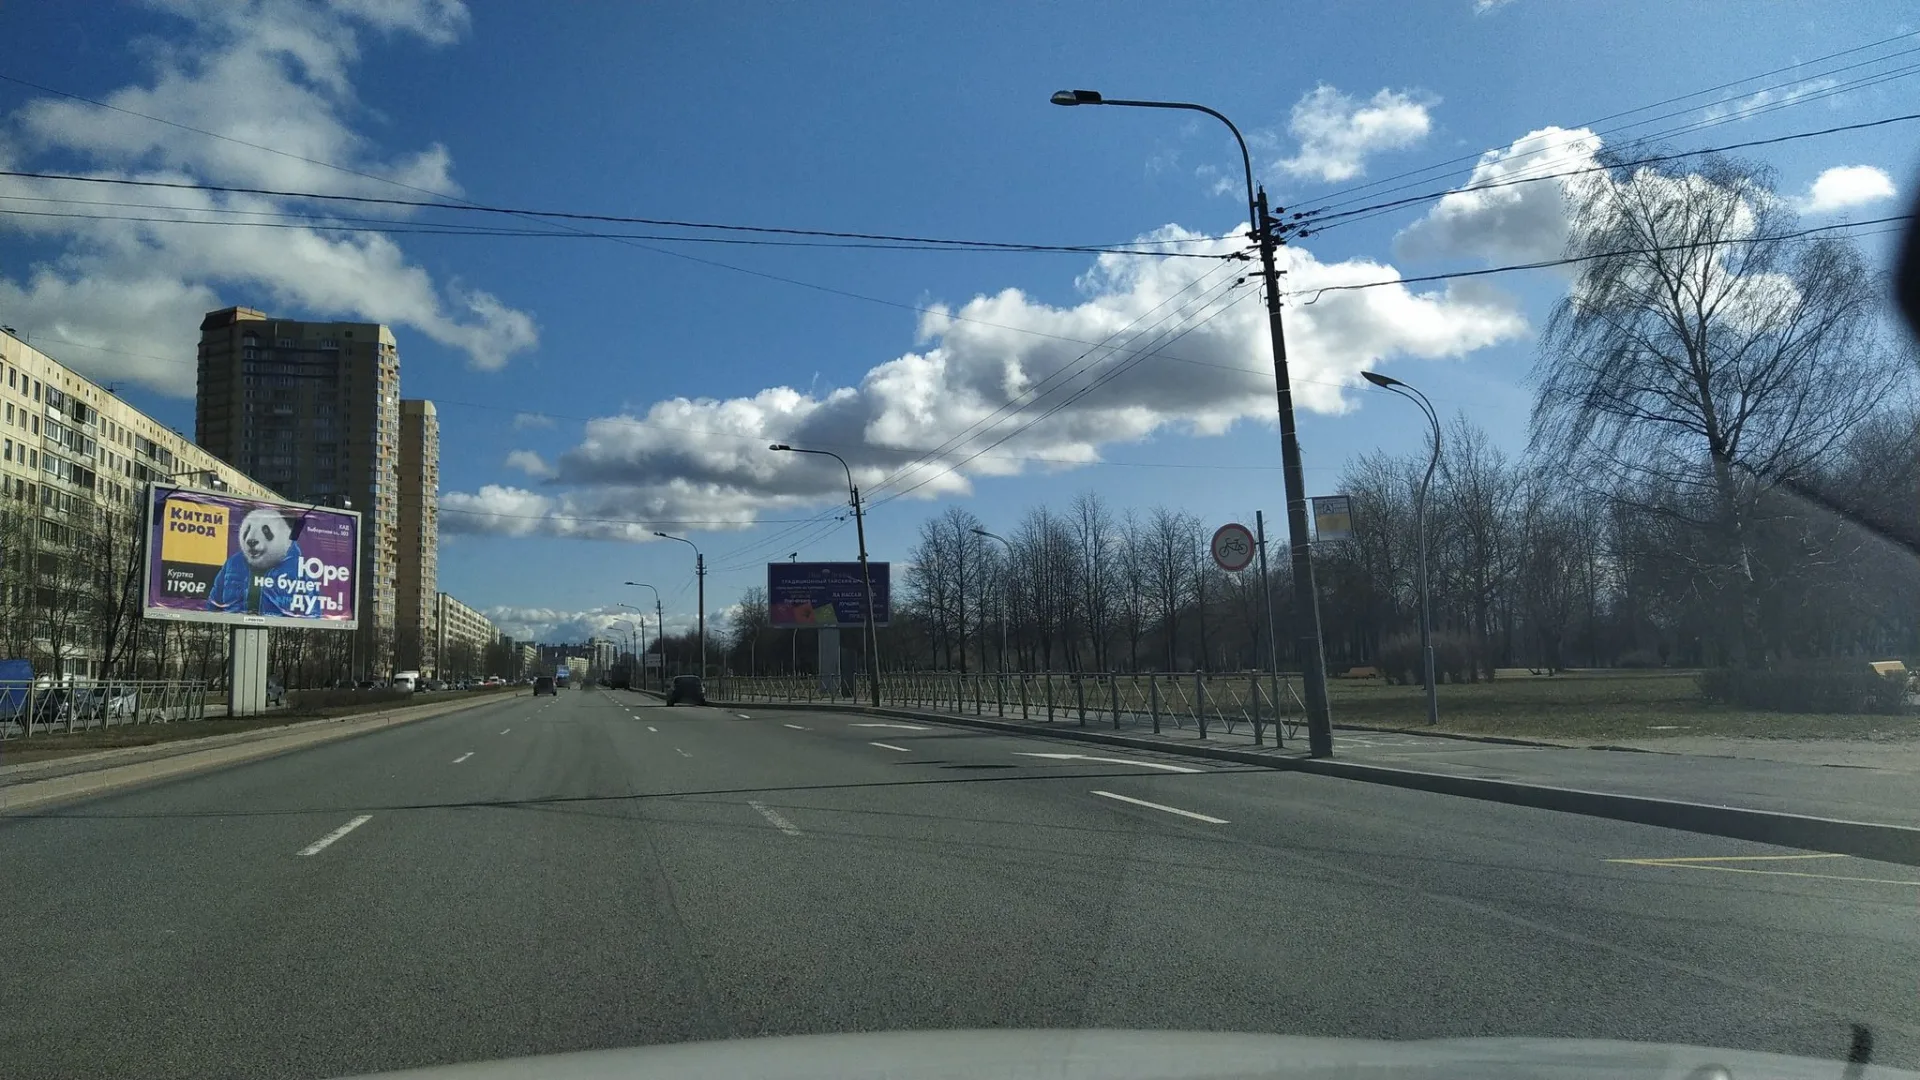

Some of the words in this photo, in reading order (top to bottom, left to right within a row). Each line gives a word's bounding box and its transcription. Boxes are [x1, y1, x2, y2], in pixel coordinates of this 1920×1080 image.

[171, 507, 223, 525] КИТАЙ
[170, 521, 216, 537] ГОРОД
[167, 568, 194, 579] Куртка
[298, 556, 350, 587] Юре
[254, 576, 274, 588] не
[277, 573, 321, 594] будет
[290, 592, 343, 615] дуть!
